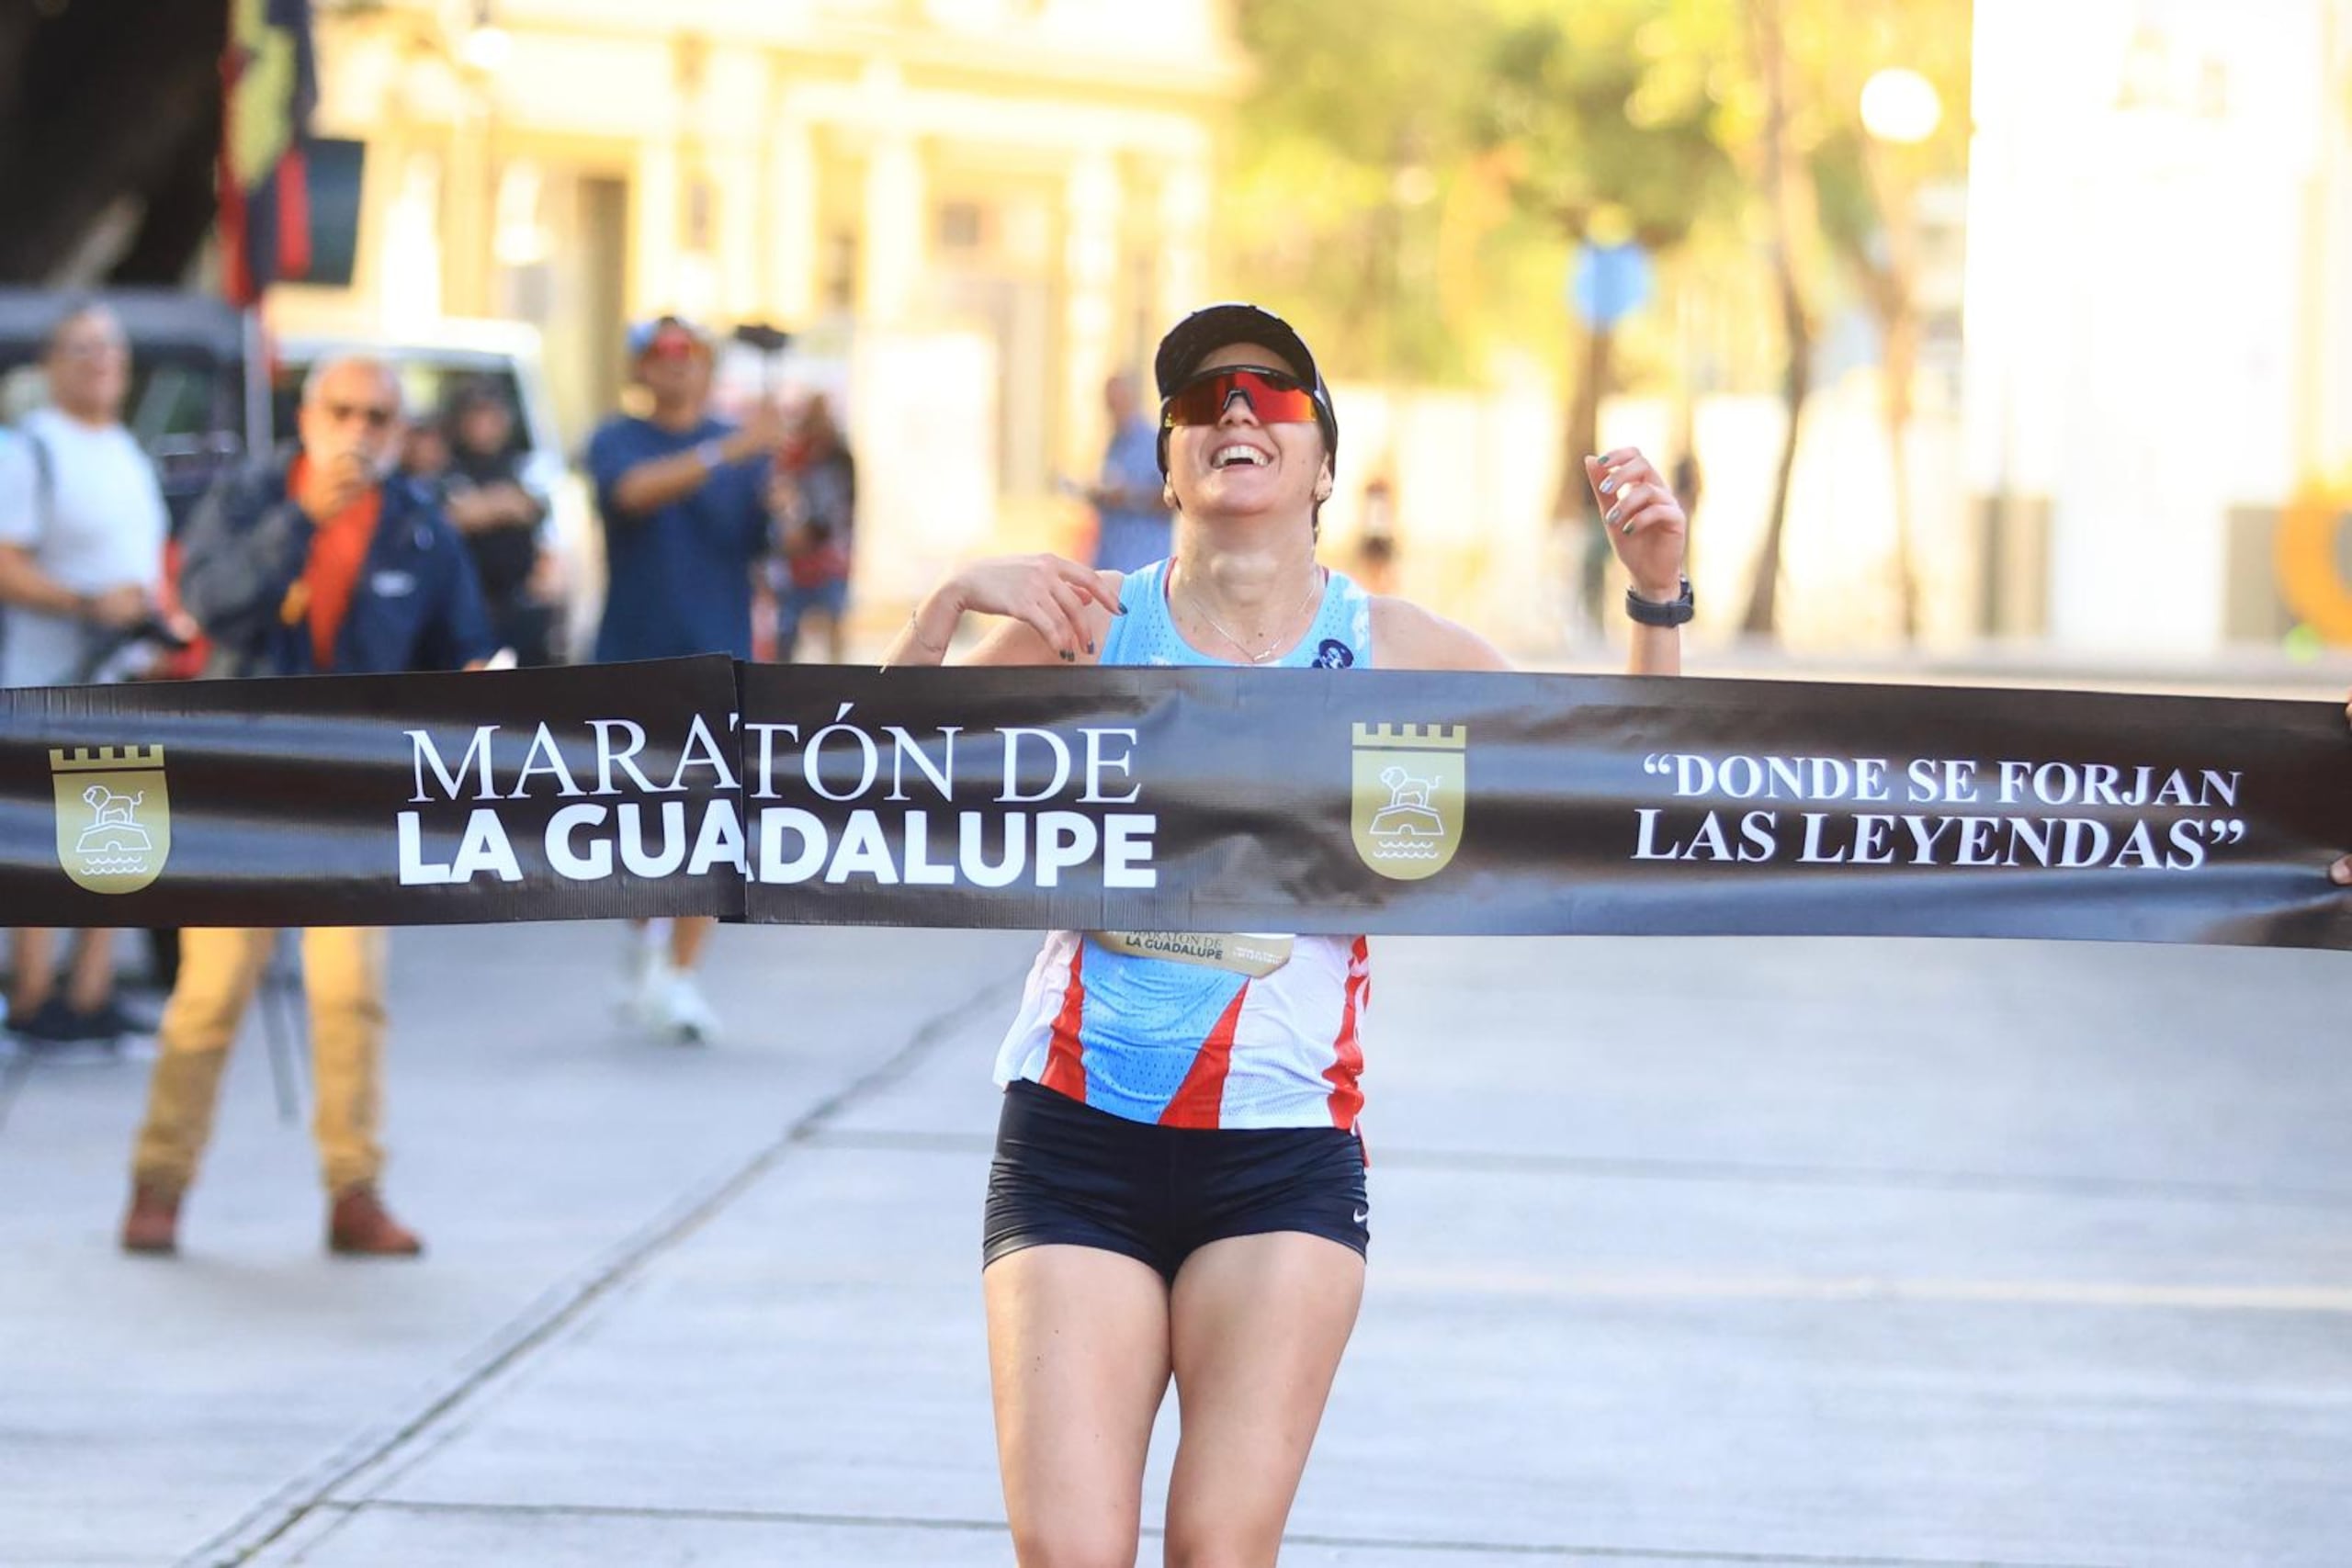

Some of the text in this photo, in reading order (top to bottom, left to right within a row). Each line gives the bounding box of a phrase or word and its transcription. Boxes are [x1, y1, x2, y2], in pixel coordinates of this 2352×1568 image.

[403, 702, 1142, 804] MARATÓN DE
[1643, 753, 2243, 807] “DONDE SE FORJAN
[397, 798, 1158, 888] LA GUADALUPE
[1631, 807, 2246, 871] LAS LEYENDAS”
[1125, 935, 1142, 947] LA
[1145, 939, 1223, 960] GUADALUPE
